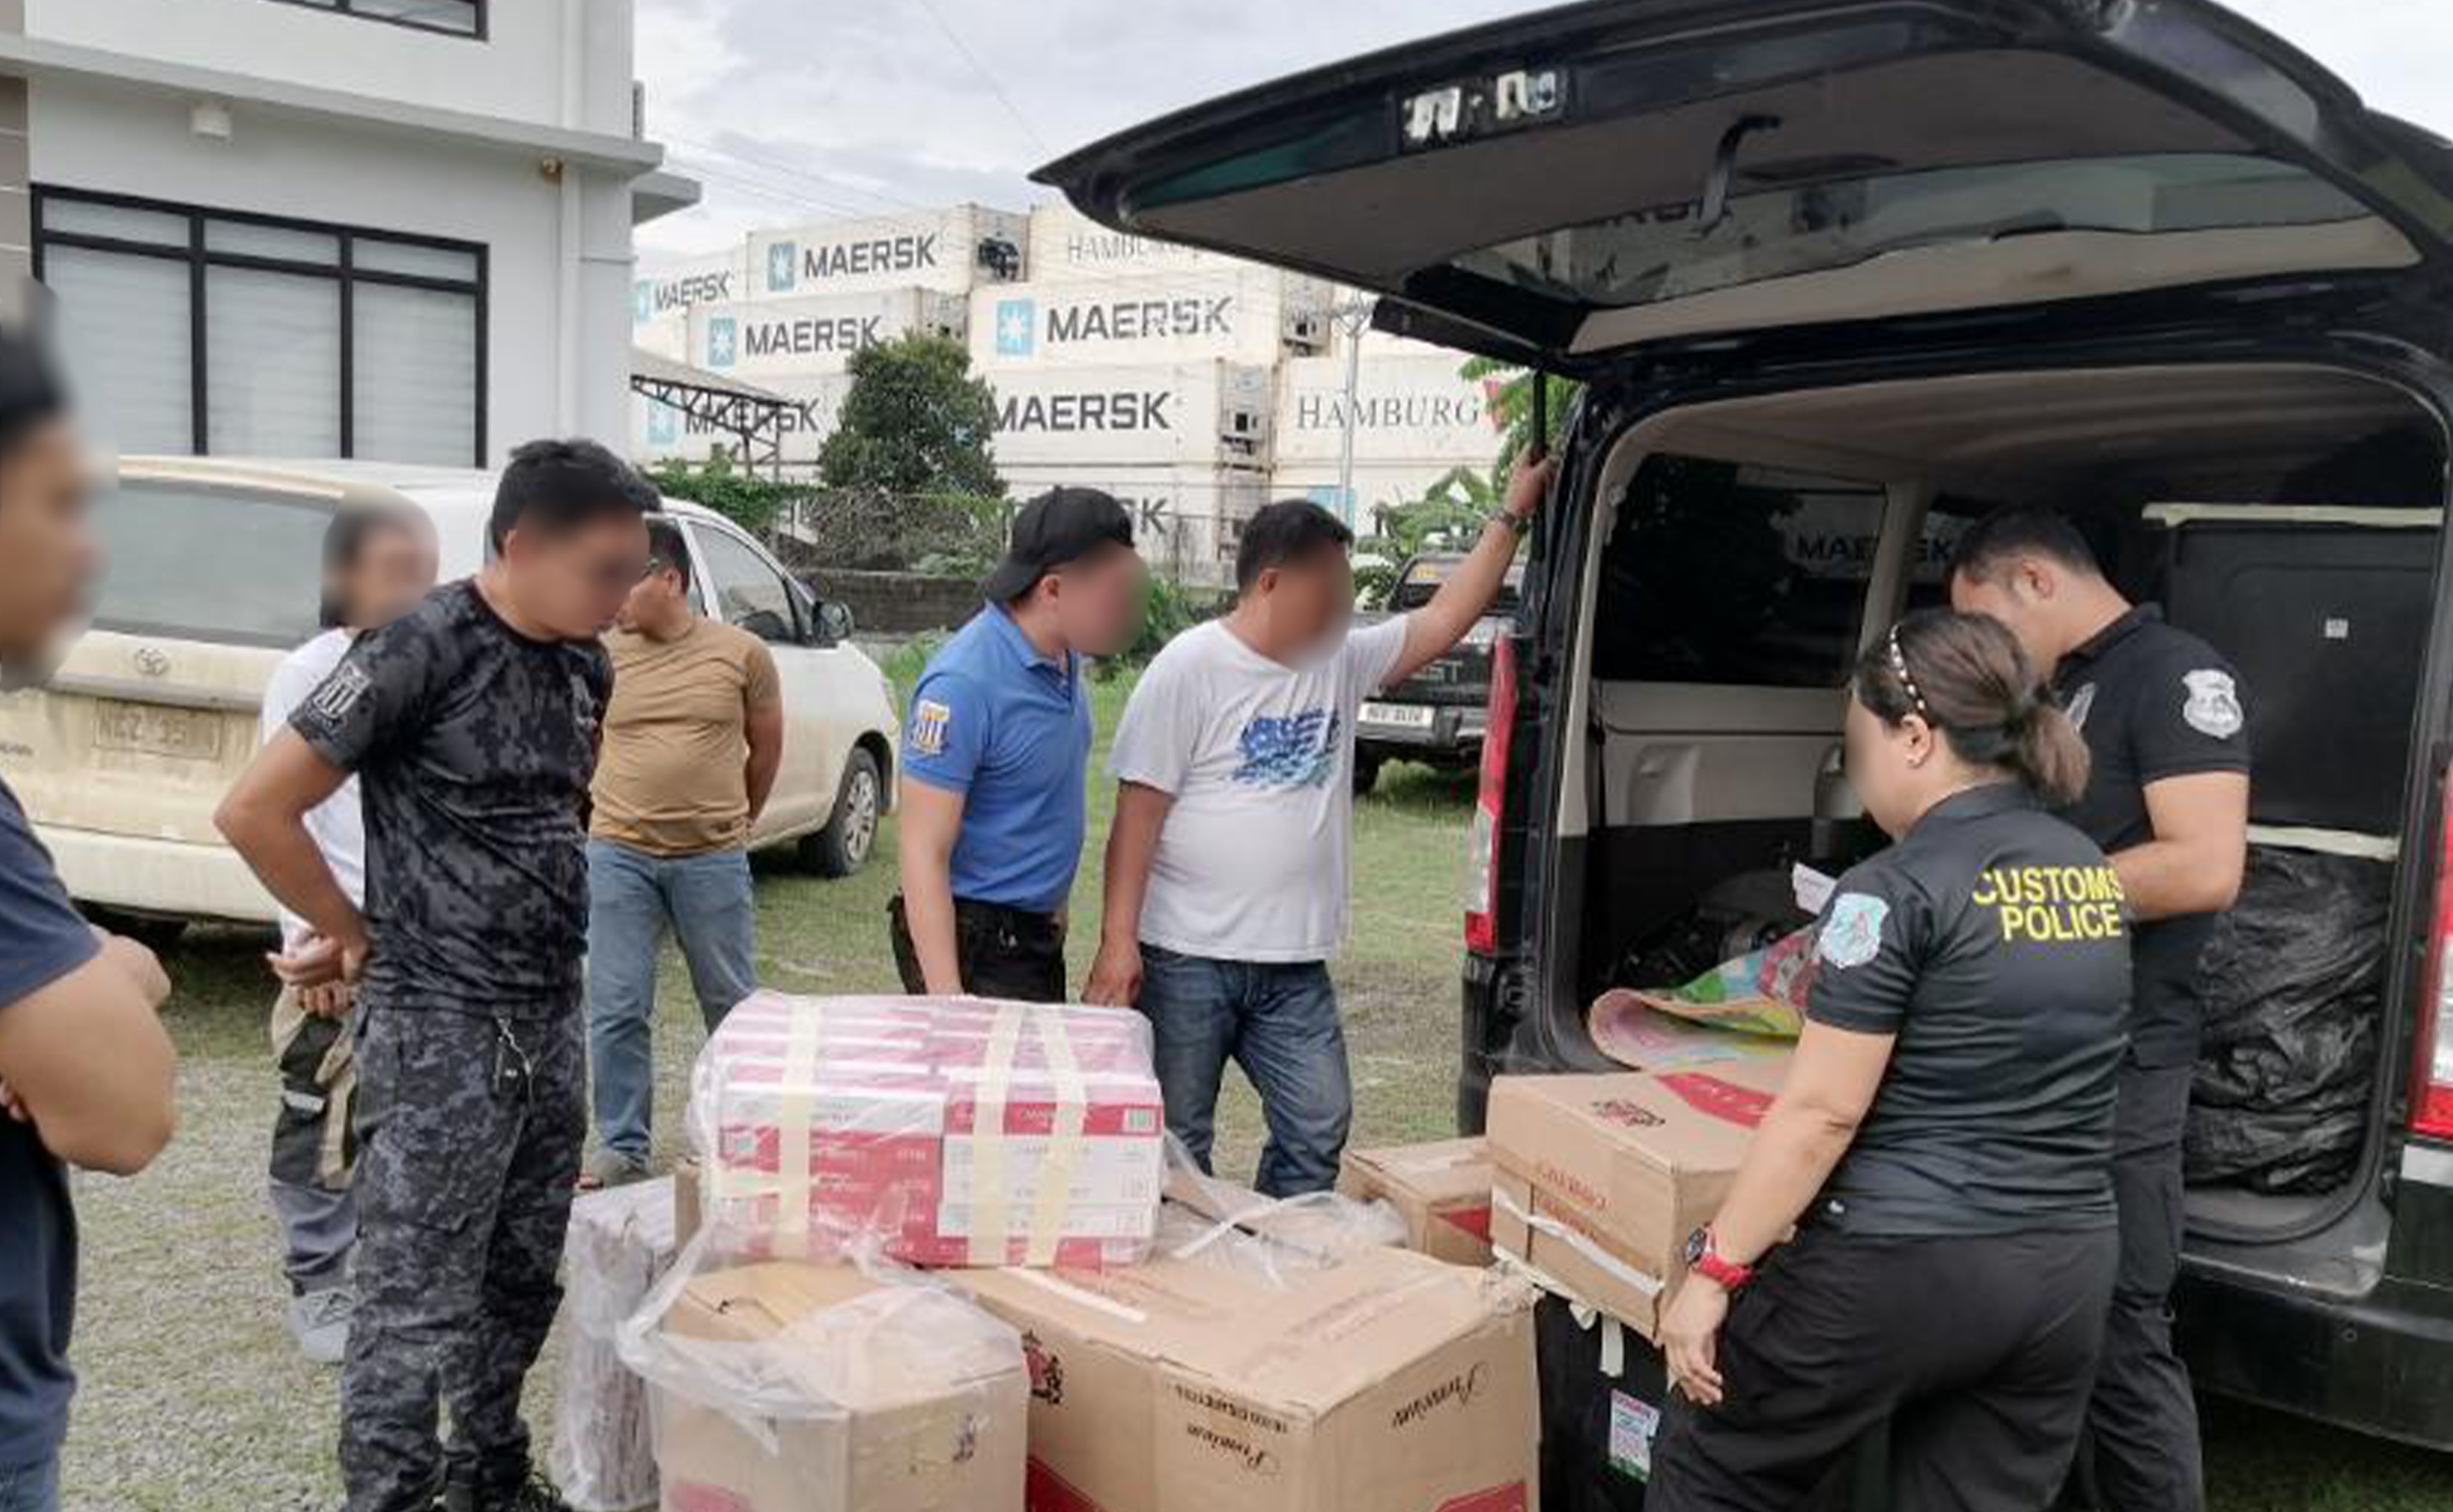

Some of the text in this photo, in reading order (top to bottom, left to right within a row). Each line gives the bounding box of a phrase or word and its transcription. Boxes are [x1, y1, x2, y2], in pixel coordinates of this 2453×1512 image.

[805, 234, 936, 277] MAERSK
[745, 315, 881, 356] MAERSK
[1047, 295, 1233, 342] MAERSK
[1297, 394, 1480, 429] HAMBURG
[1972, 866, 2125, 904] CUSTOMS
[2000, 902, 2123, 942] POLICE
